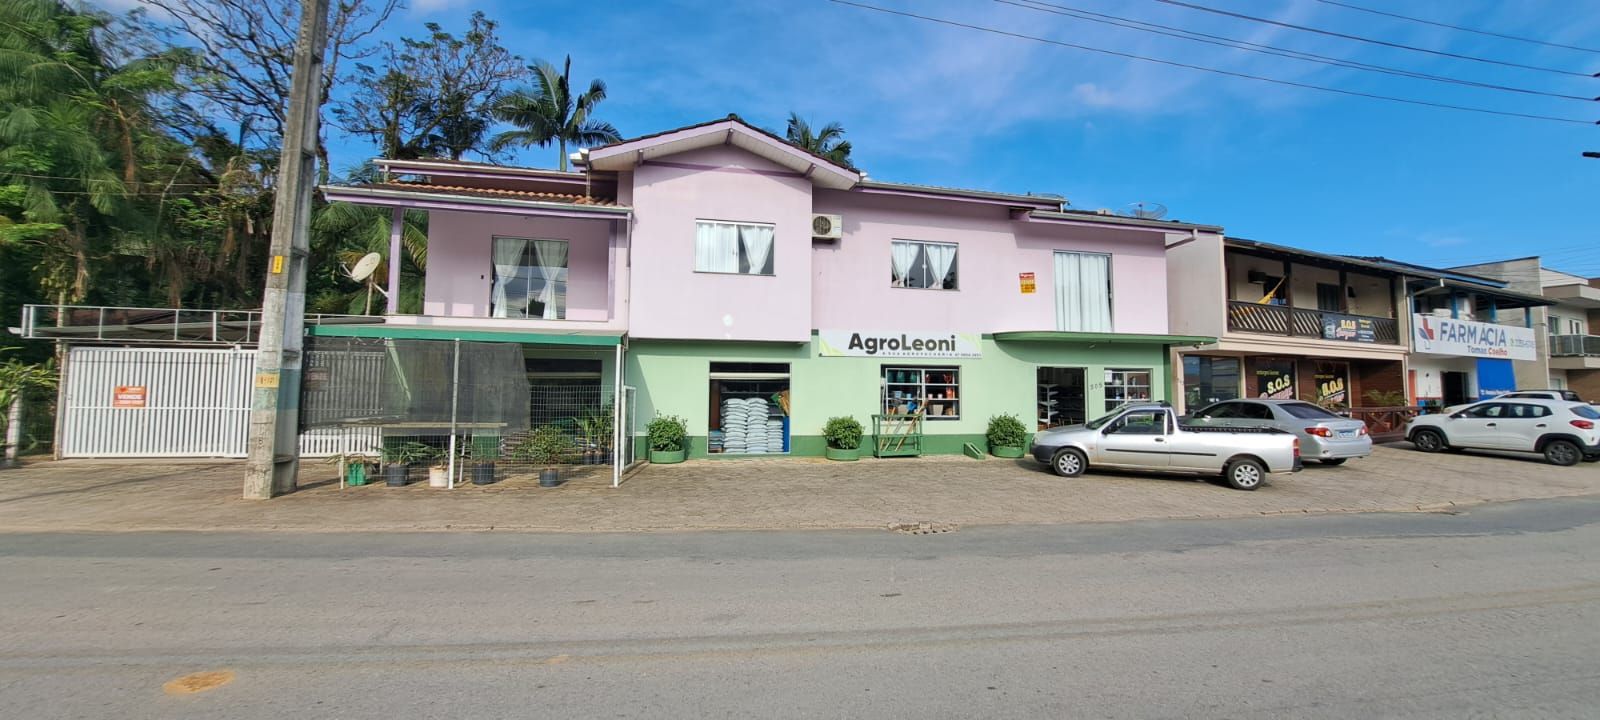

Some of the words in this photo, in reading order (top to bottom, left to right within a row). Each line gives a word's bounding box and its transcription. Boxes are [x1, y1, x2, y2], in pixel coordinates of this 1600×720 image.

[848, 332, 956, 355] AgroLeoni
[1440, 322, 1506, 346] FARMÁCIA
[1267, 374, 1290, 394] S.O.S
